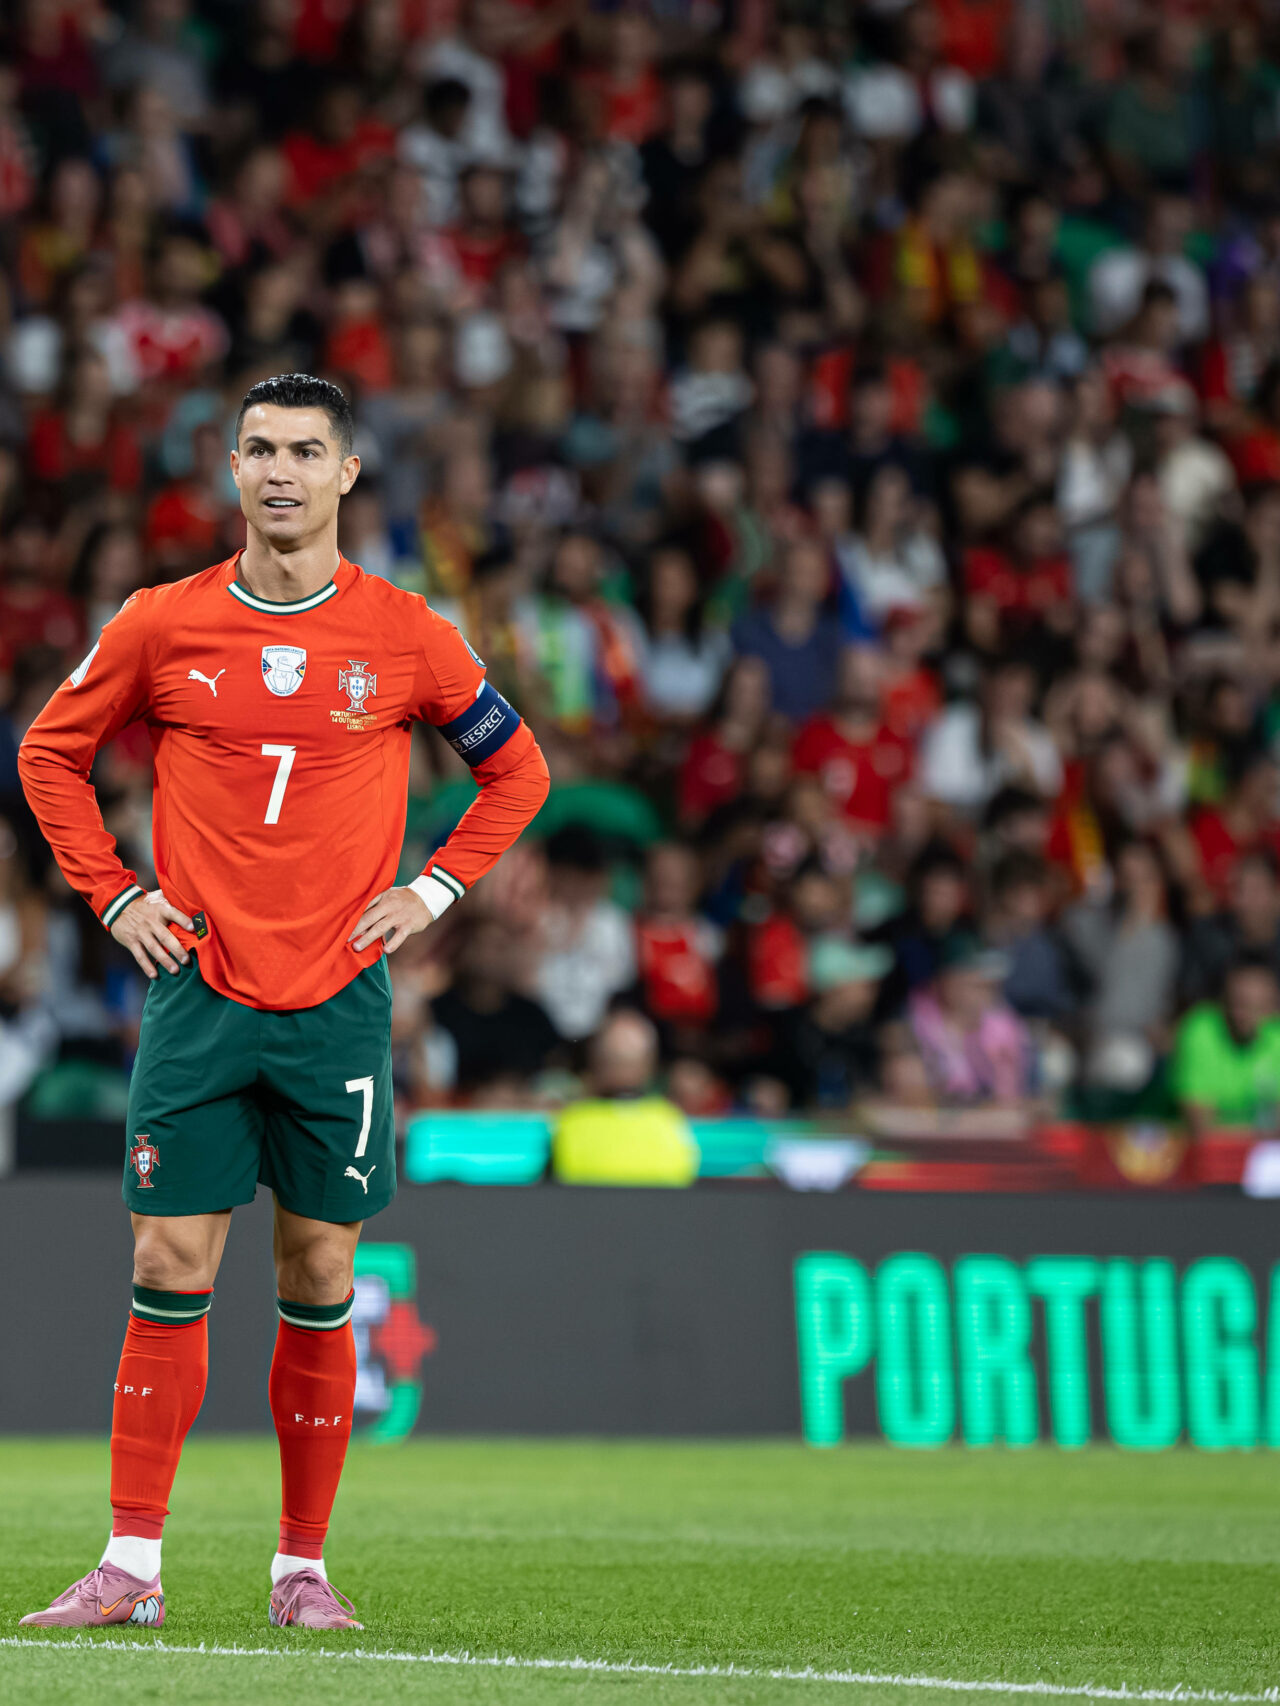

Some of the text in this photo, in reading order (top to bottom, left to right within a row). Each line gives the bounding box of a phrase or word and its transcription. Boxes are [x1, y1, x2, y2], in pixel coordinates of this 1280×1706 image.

[461, 707, 503, 747] RESPECT
[261, 744, 296, 825] 7
[345, 1075, 374, 1158] 7
[795, 1251, 1280, 1452] PORTUG
